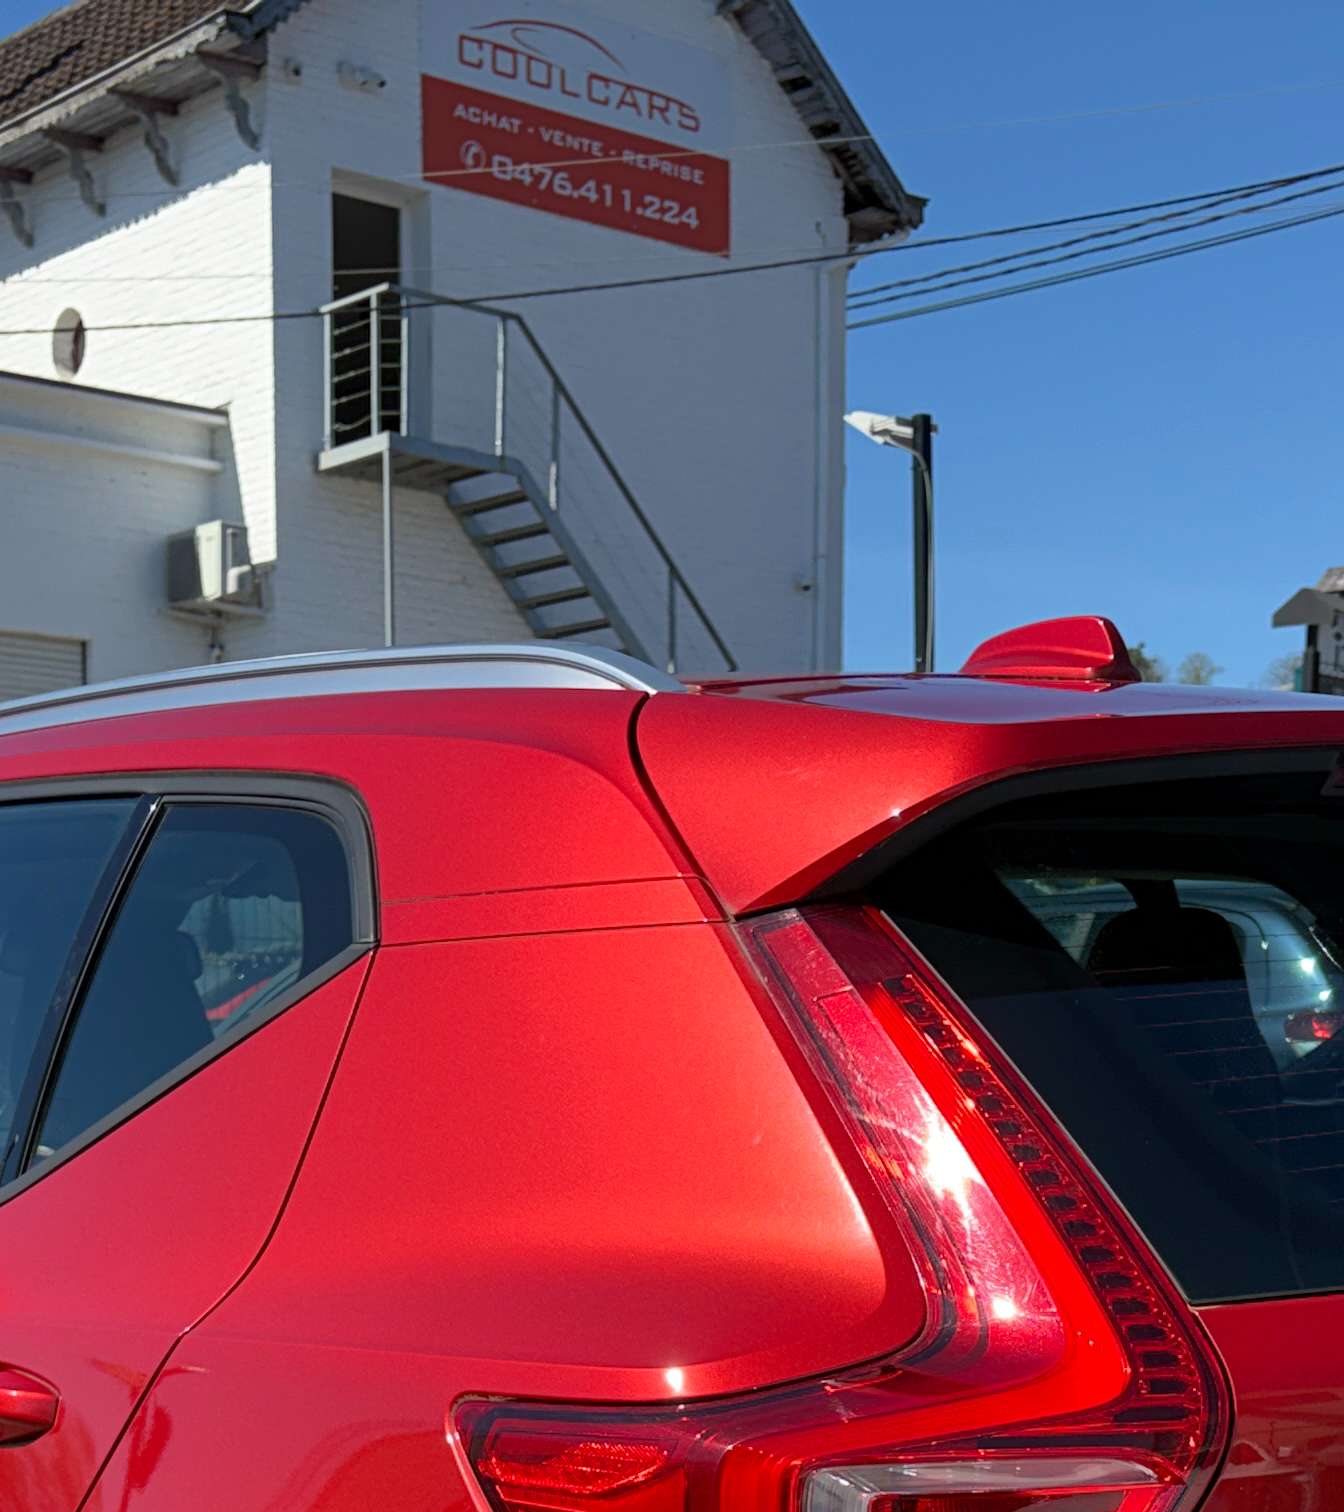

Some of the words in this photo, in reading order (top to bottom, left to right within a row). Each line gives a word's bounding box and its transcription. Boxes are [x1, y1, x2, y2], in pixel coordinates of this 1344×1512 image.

[459, 34, 701, 132] COOLCARS
[453, 103, 521, 134] ACHAT
[539, 127, 604, 157] VENTE
[622, 149, 704, 185] REPRISE
[491, 155, 699, 229] 0476.411.224
